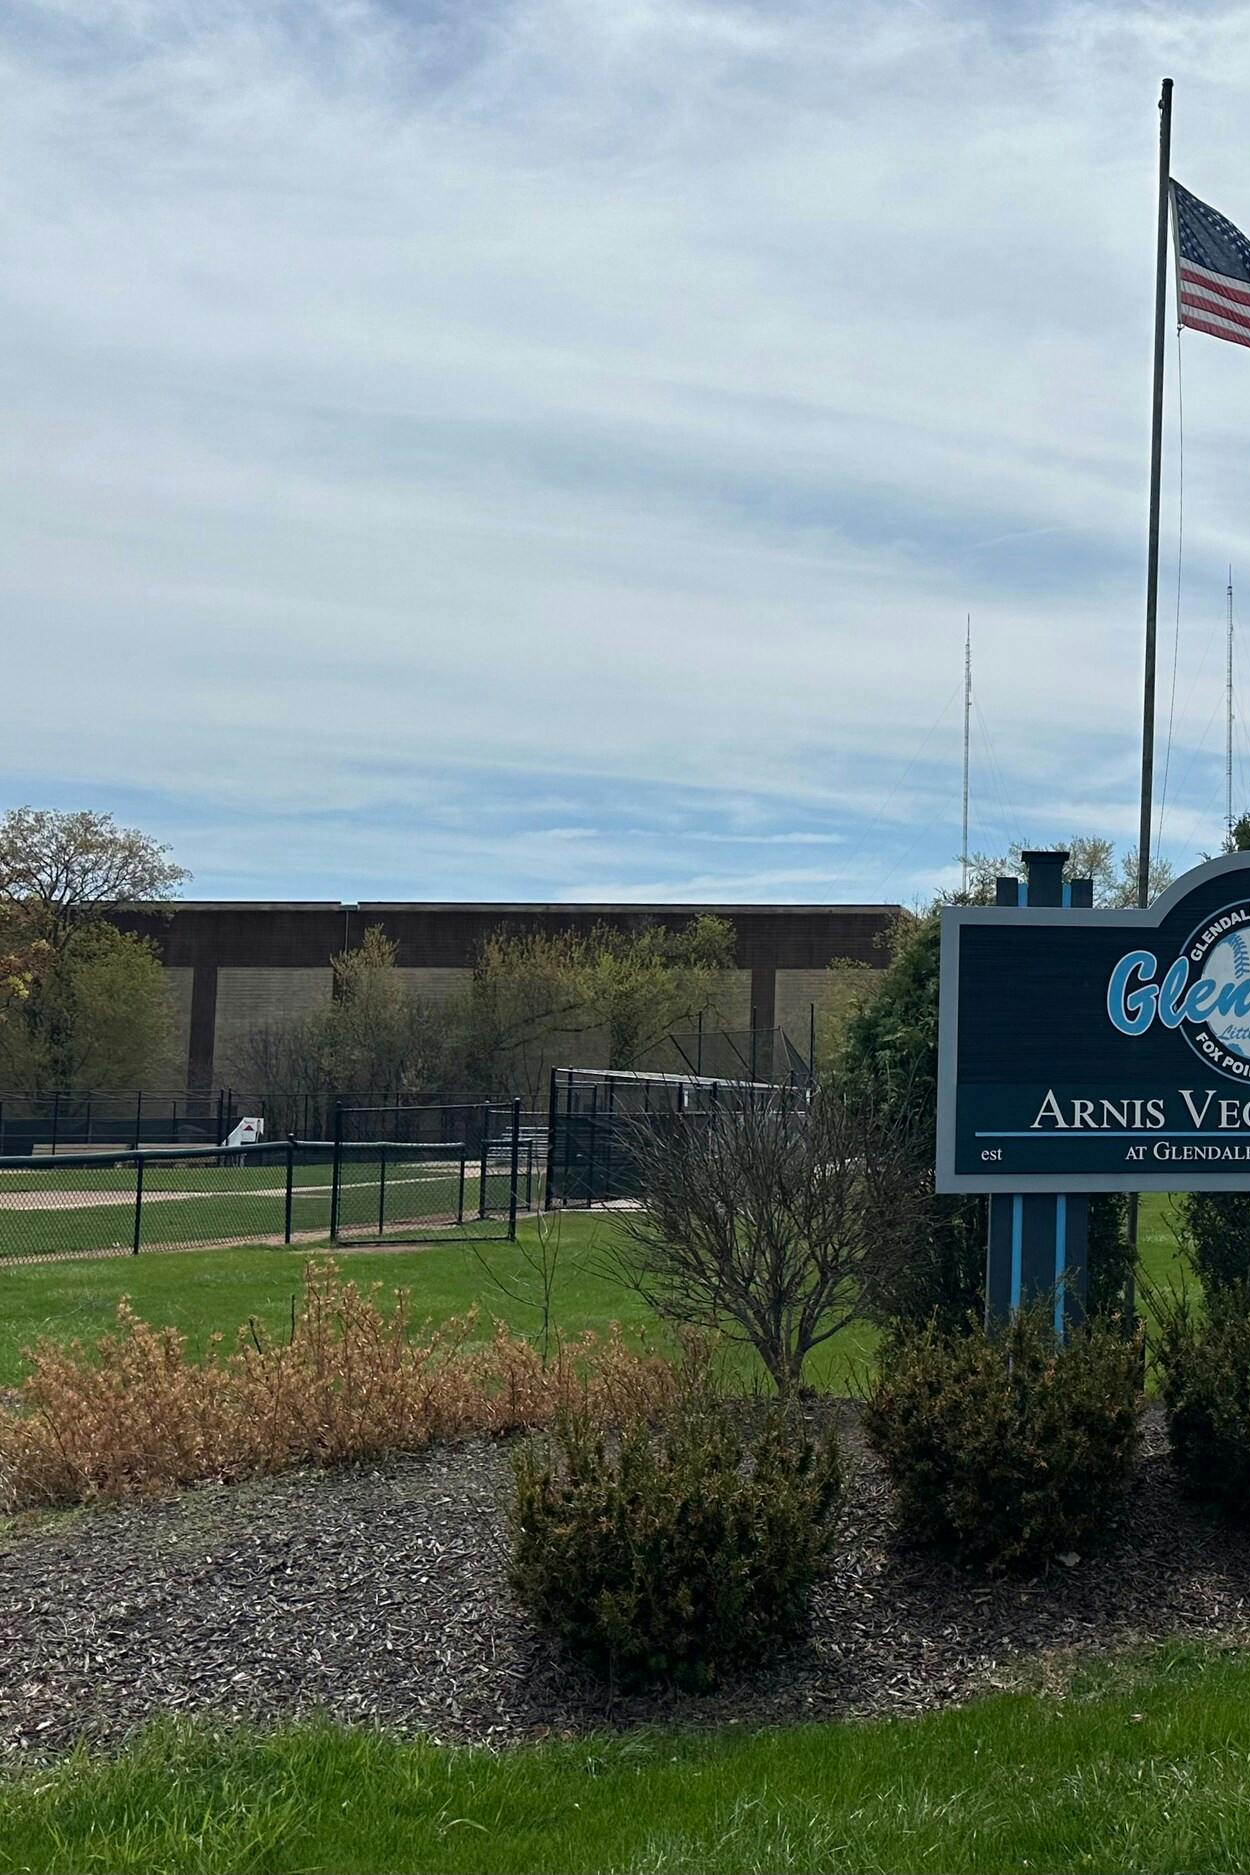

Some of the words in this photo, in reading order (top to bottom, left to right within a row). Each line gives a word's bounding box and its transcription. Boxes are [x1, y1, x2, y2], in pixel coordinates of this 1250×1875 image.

[1195, 1032, 1224, 1062] FOX
[1029, 1088, 1167, 1129] ARNIS
[980, 1147, 1003, 1162] est
[1125, 1145, 1148, 1161] AT
